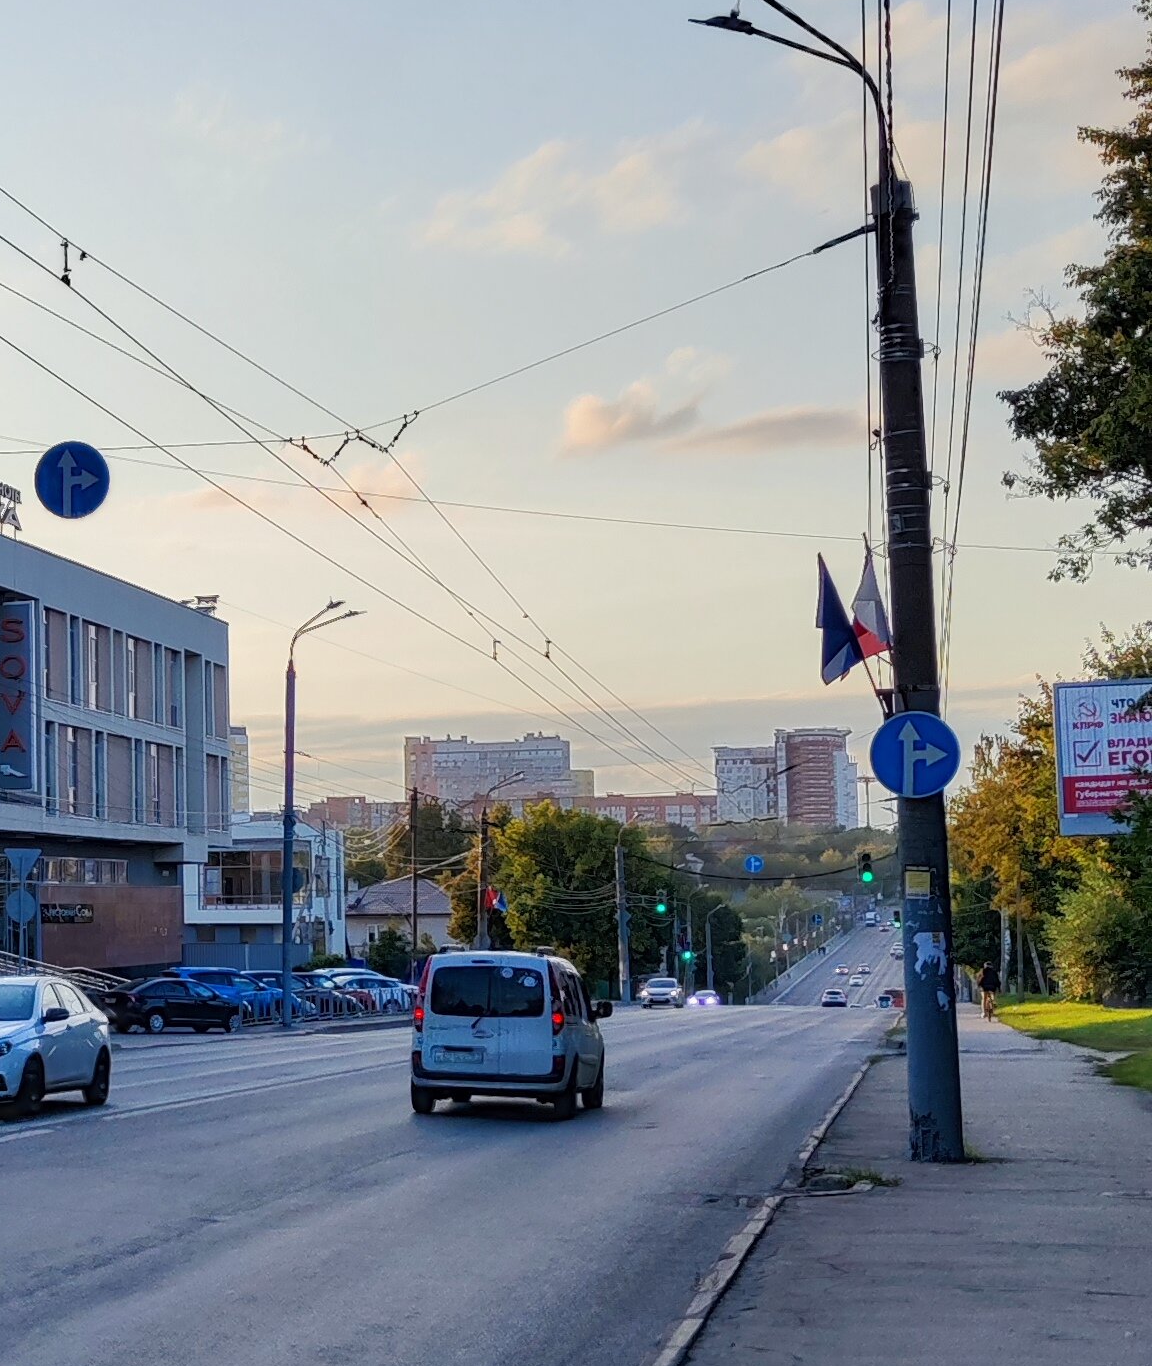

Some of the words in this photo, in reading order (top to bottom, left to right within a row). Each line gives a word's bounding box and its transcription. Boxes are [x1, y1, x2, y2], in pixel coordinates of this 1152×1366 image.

[0, 618, 27, 753] SOVA
[1111, 698, 1135, 709] ЧТО
[1072, 721, 1104, 731] КПРФ
[1108, 750, 1152, 766] ЕГО
